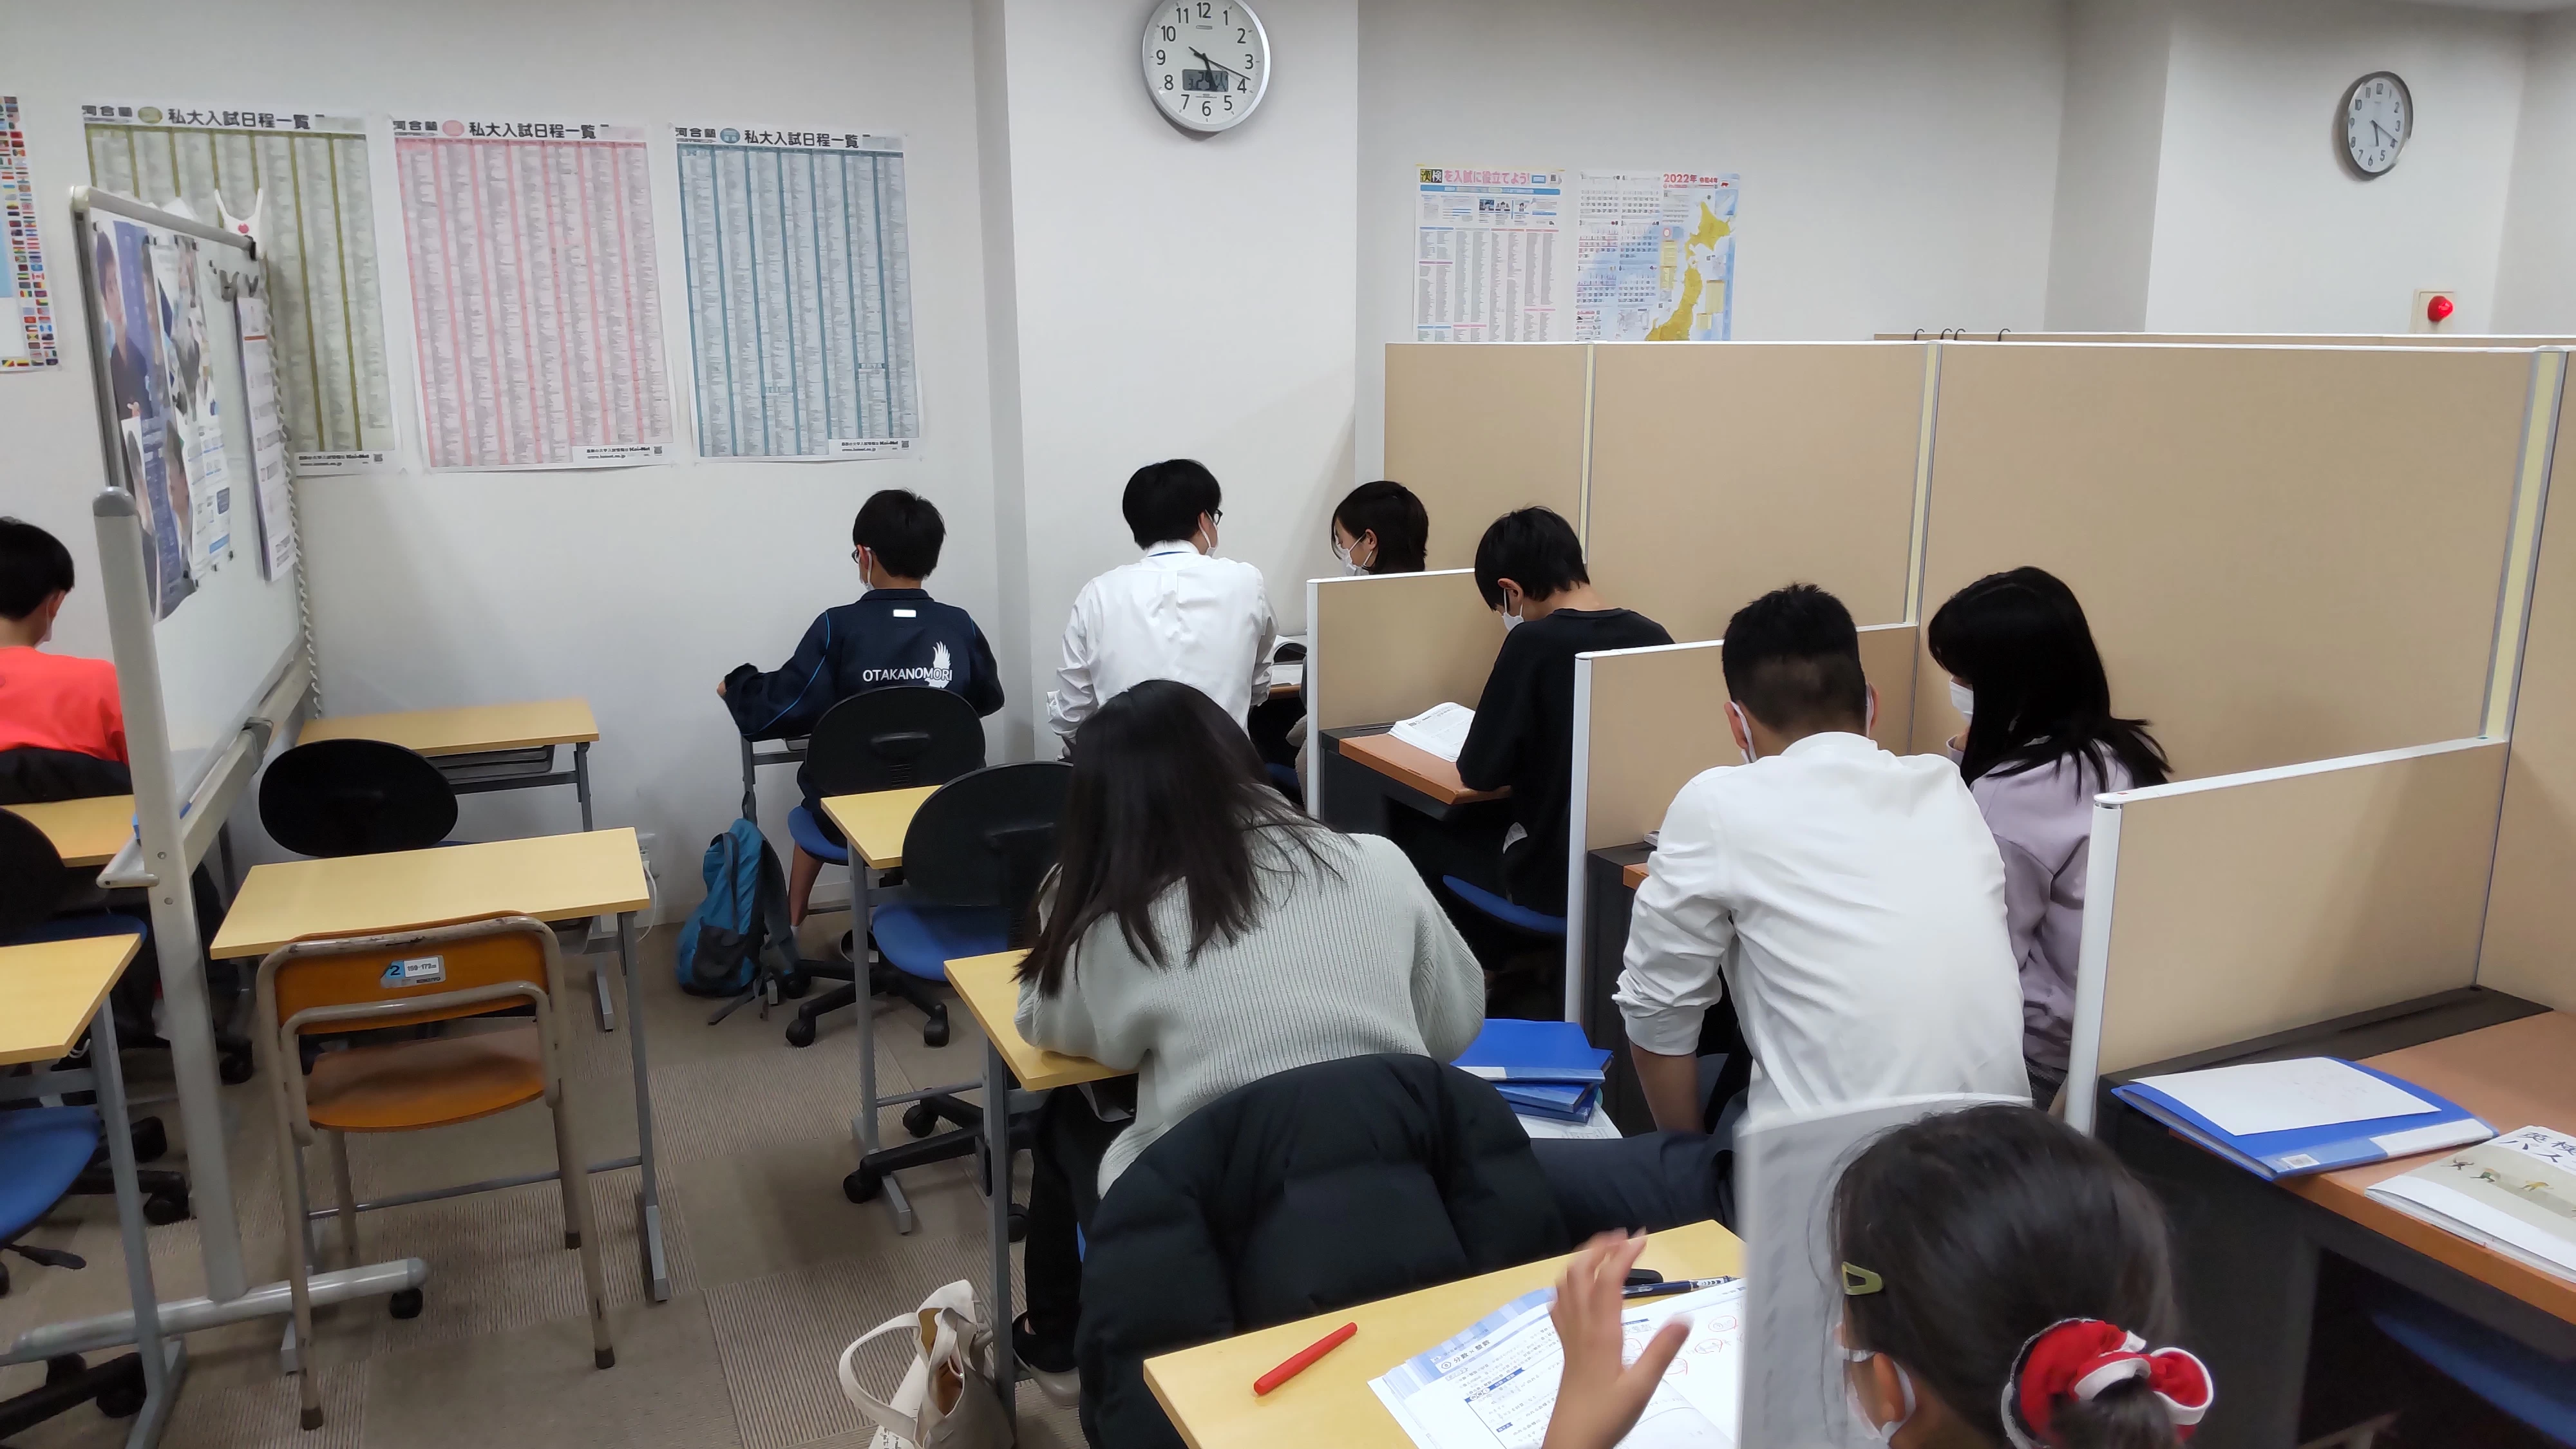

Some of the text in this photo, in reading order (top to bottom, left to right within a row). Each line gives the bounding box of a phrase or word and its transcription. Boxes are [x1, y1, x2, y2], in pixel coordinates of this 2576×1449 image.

[1176, 7, 1189, 24] 11
[1197, 3, 1211, 19] 12
[1223, 10, 1228, 26] 1
[1160, 25, 1176, 42] 10
[1236, 28, 1246, 44] 2
[1156, 49, 1166, 66] 9
[1245, 53, 1253, 70] 3
[1164, 74, 1174, 91] 8
[1236, 78, 1247, 94] 4
[1180, 93, 1190, 110] 7
[1202, 100, 1211, 117] 6
[1224, 95, 1233, 111] 5
[2394, 102, 2400, 113] 2
[168, 108, 310, 129] 私大入試日程一覧
[469, 122, 596, 139] 私大入試日程一覧
[744, 130, 859, 148] 私大入試日程一覧
[2358, 149, 2363, 162] 7
[2368, 155, 2373, 166] 6
[2380, 149, 2385, 162] 5
[1663, 173, 1698, 183] 2022年
[862, 667, 952, 682] OTAKANOMORI
[390, 965, 401, 976] 2
